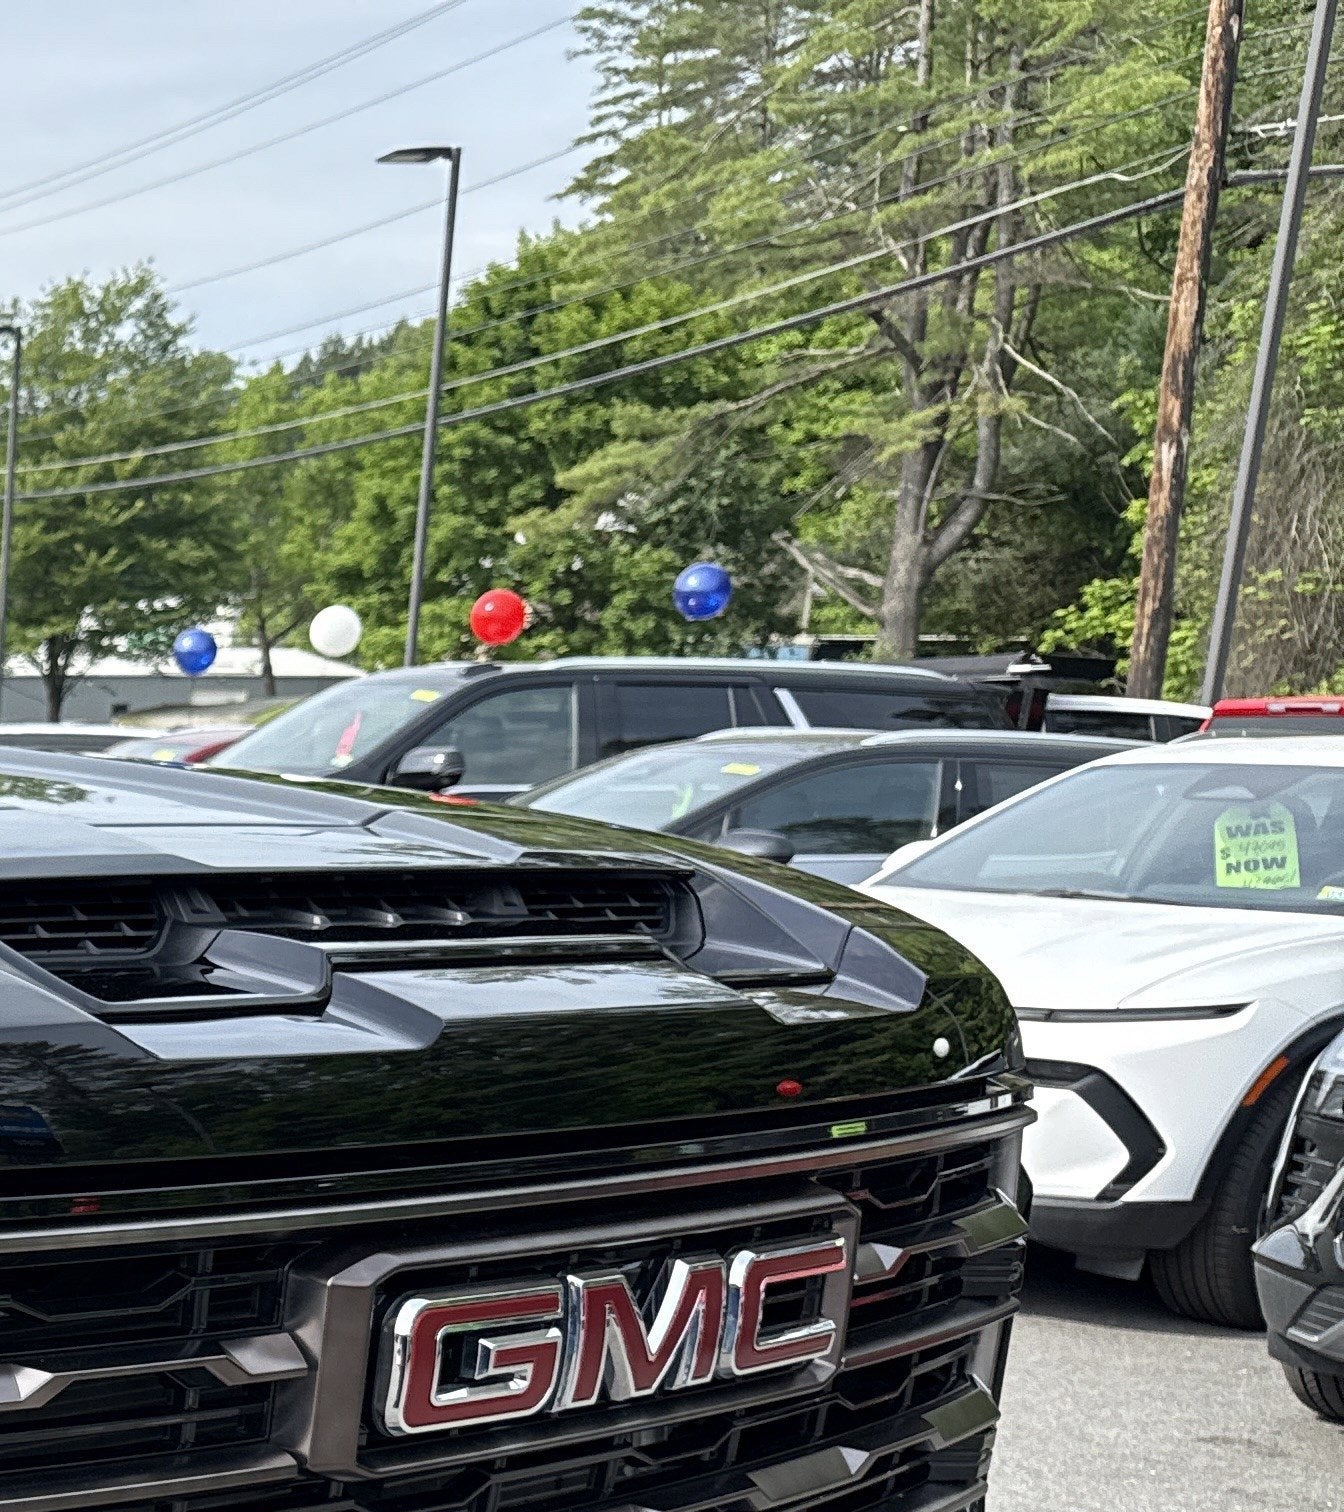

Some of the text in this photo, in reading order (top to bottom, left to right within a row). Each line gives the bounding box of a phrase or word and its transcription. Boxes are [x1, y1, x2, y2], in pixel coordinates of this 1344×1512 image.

[1226, 820, 1285, 838] WAS
[1225, 856, 1288, 875] NOW
[385, 1236, 847, 1437] GMC
